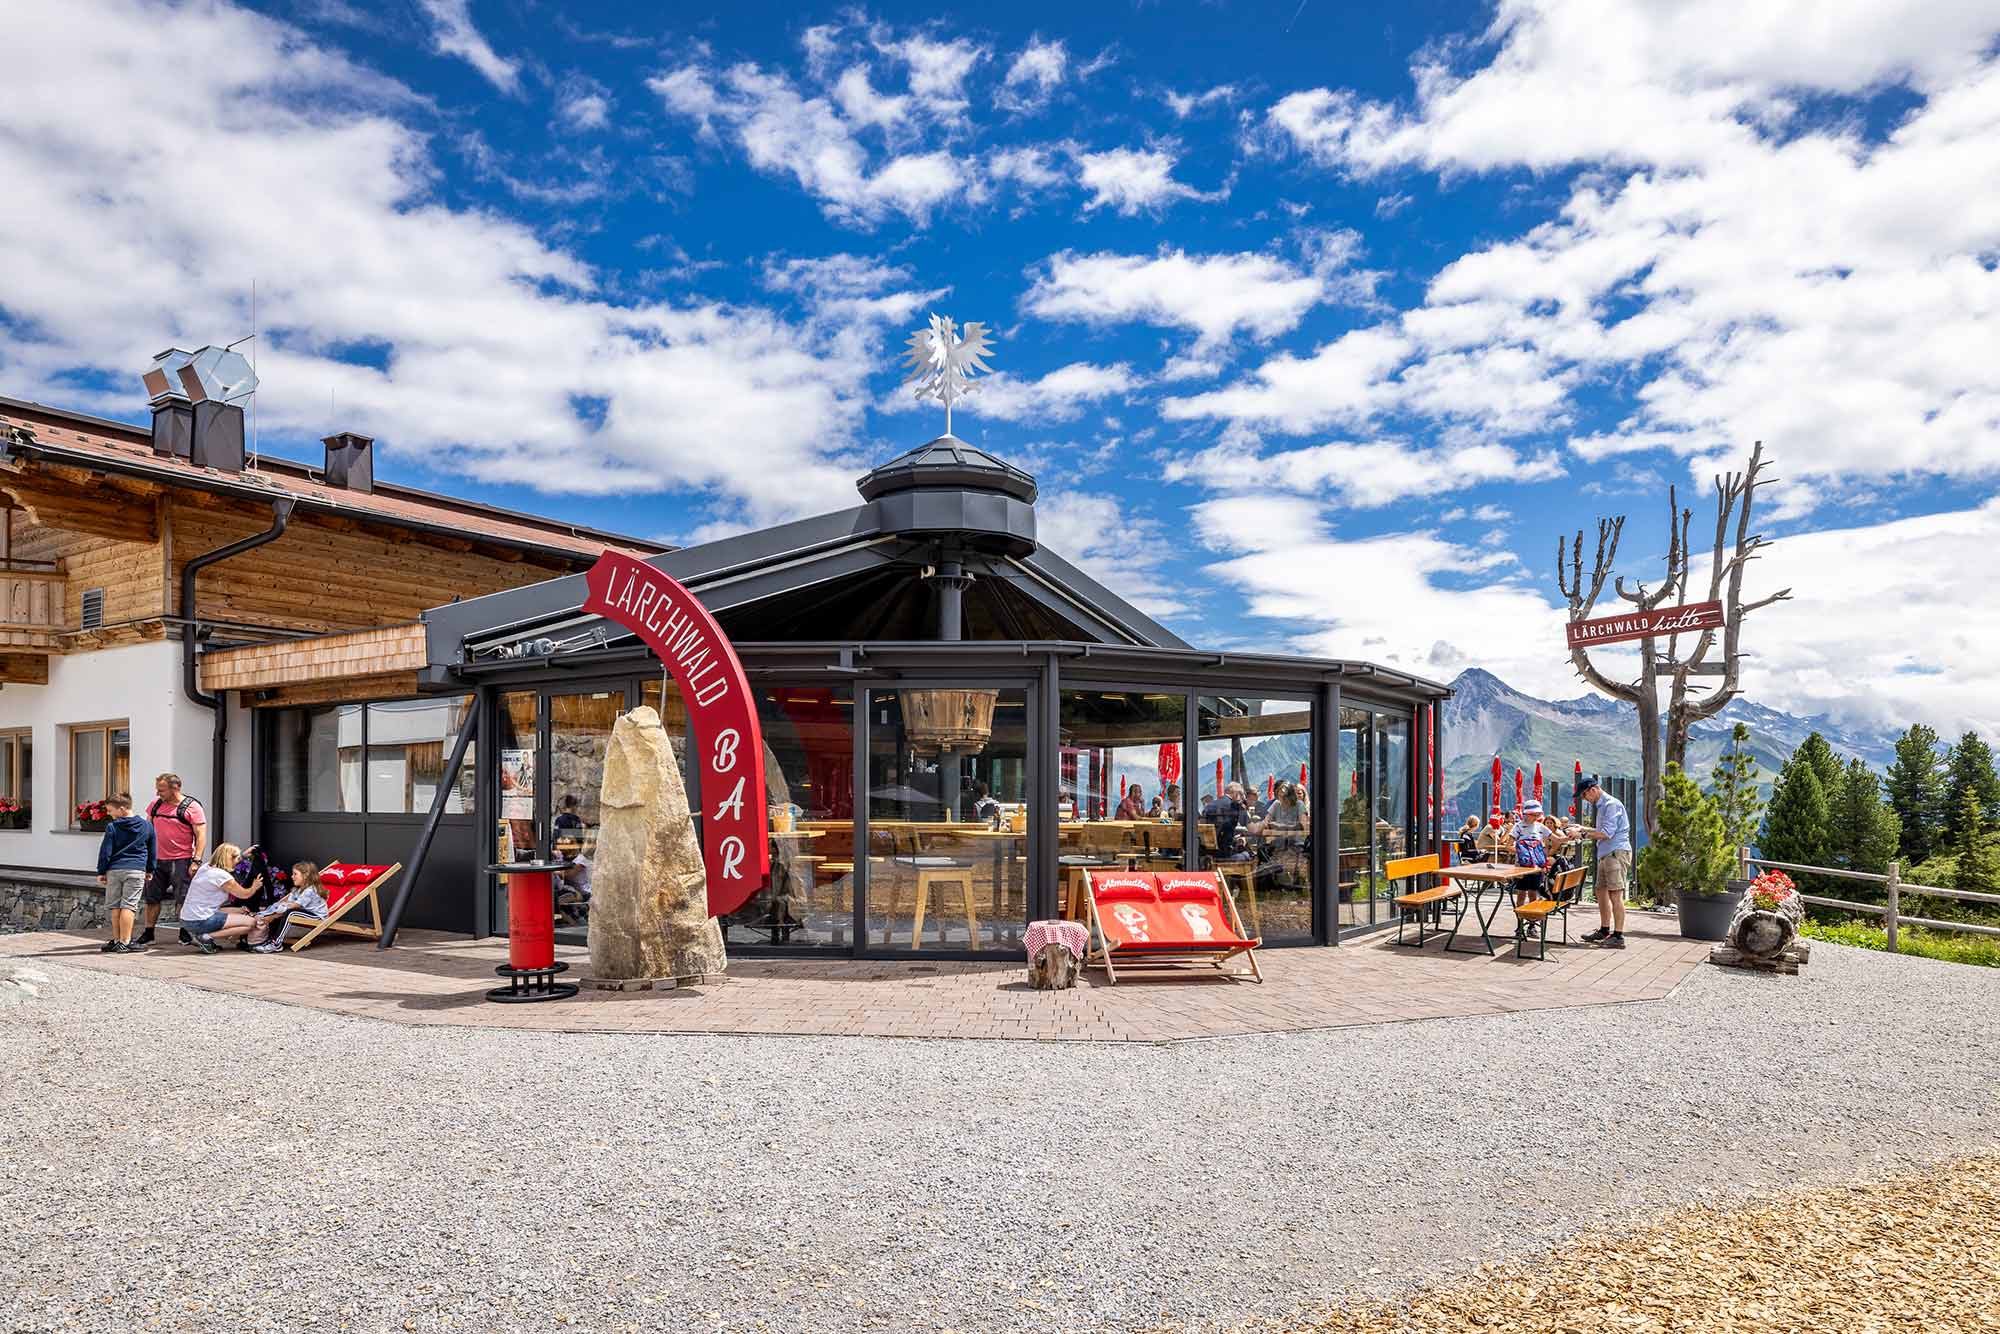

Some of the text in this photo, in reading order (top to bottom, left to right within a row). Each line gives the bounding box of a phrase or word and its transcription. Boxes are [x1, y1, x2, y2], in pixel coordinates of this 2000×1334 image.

[1573, 608, 1704, 640] LÄRCHWALD hütte
[604, 566, 746, 881] LÄRCHWALD BAR
